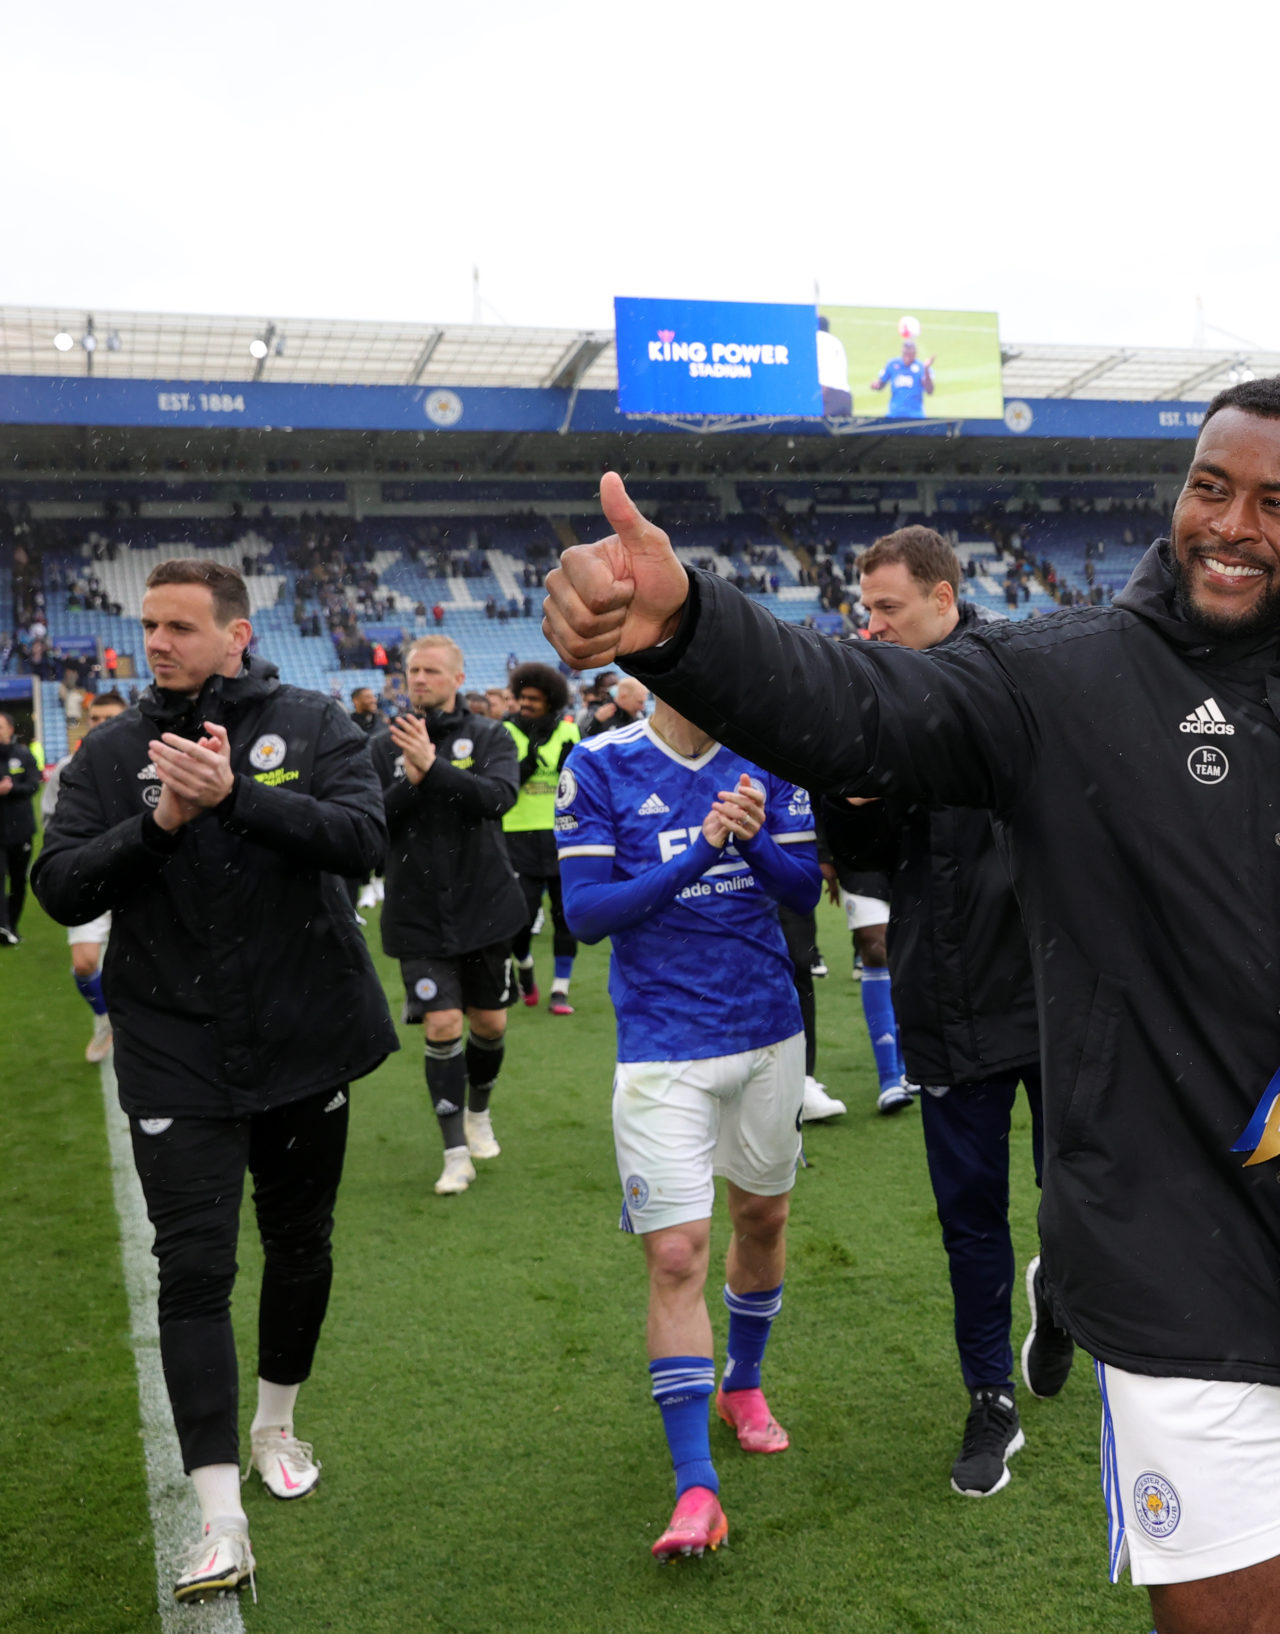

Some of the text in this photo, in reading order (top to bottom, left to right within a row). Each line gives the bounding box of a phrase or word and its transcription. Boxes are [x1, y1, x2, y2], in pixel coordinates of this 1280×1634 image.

[648, 341, 789, 364] KING POWER
[689, 362, 752, 378] STADIUM
[158, 392, 246, 412] EST. 1884
[1179, 720, 1235, 736] adidas
[1195, 764, 1221, 777] TEAM
[638, 804, 670, 815] adidas
[676, 876, 755, 899] ade online
[1136, 1477, 1175, 1503] LEICESTER CITY
[1138, 1506, 1178, 1533] FOOTBALL CLUB
